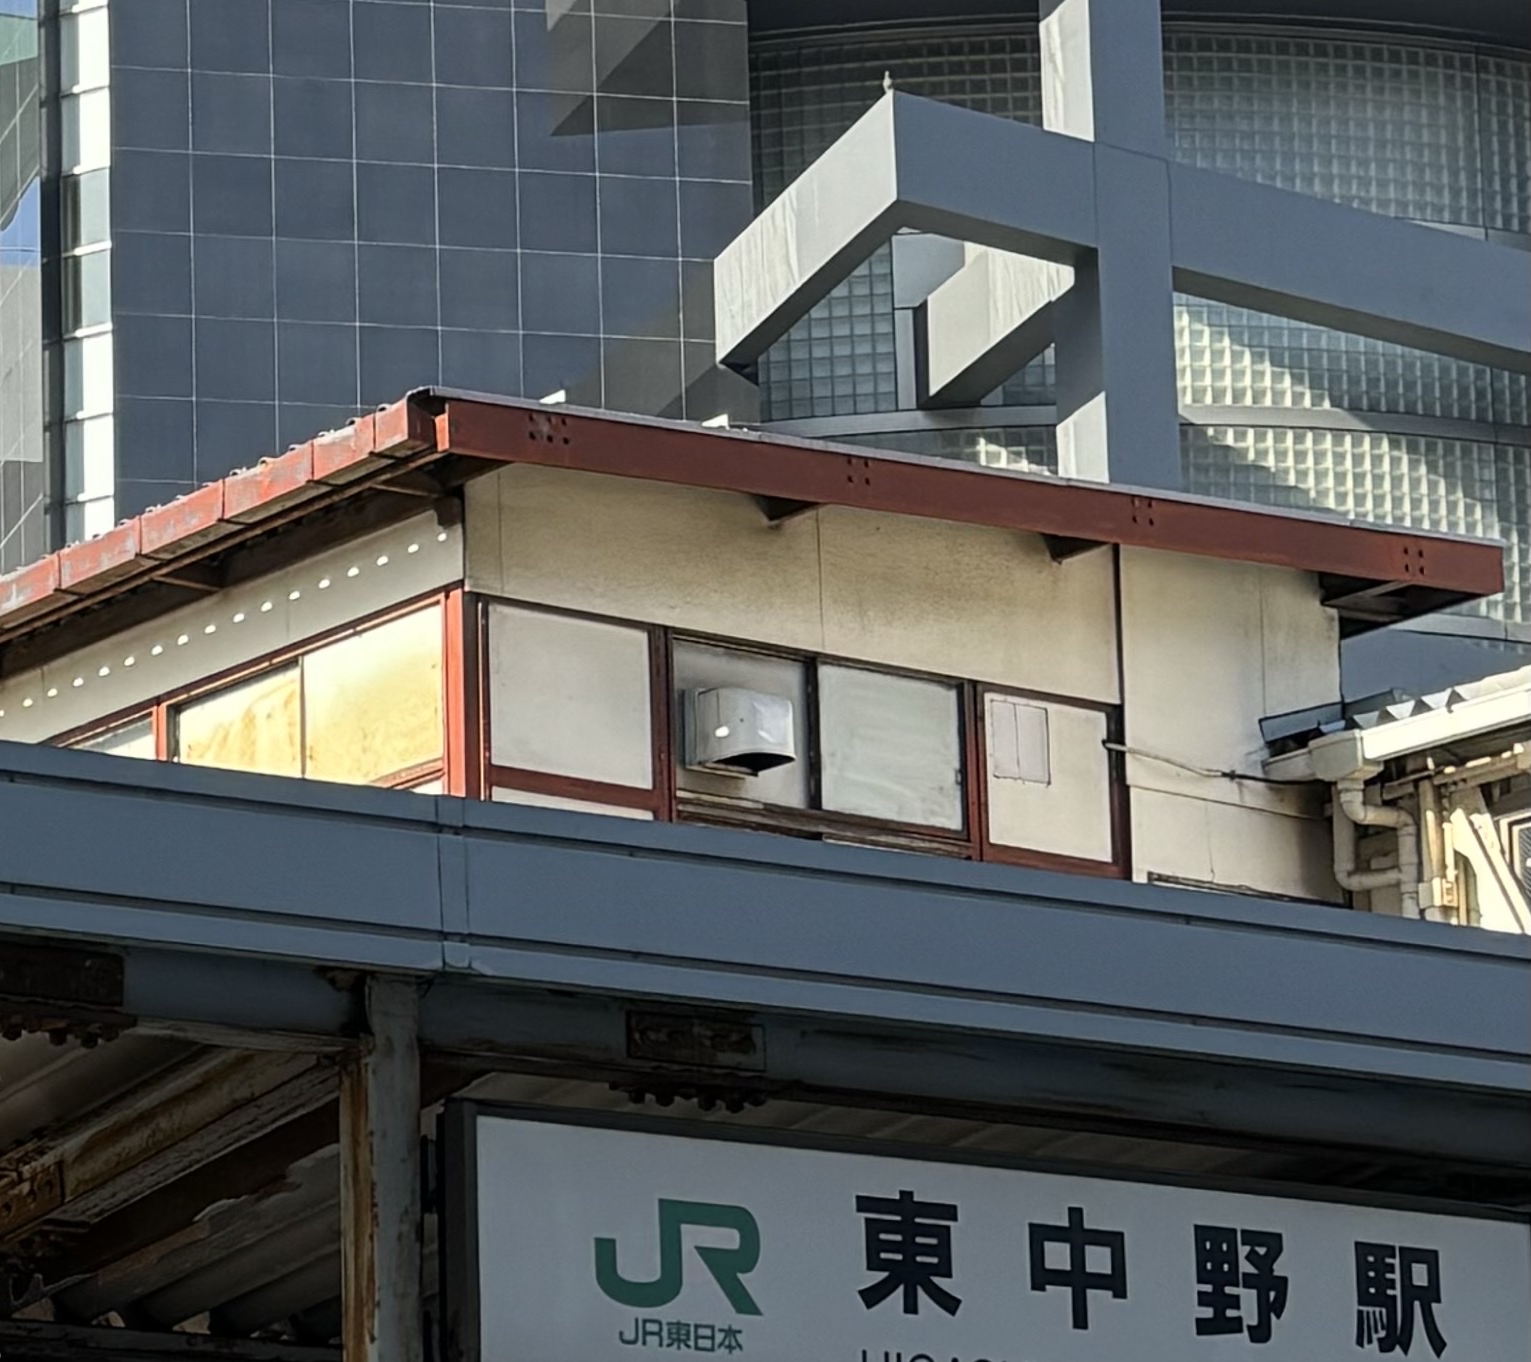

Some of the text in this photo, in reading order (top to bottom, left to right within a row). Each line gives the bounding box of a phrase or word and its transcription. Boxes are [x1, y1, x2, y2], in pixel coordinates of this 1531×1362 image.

[593, 1197, 765, 1317] JR
[854, 1189, 1448, 1359] 東中野駅
[618, 1317, 744, 1355] JR東日本
